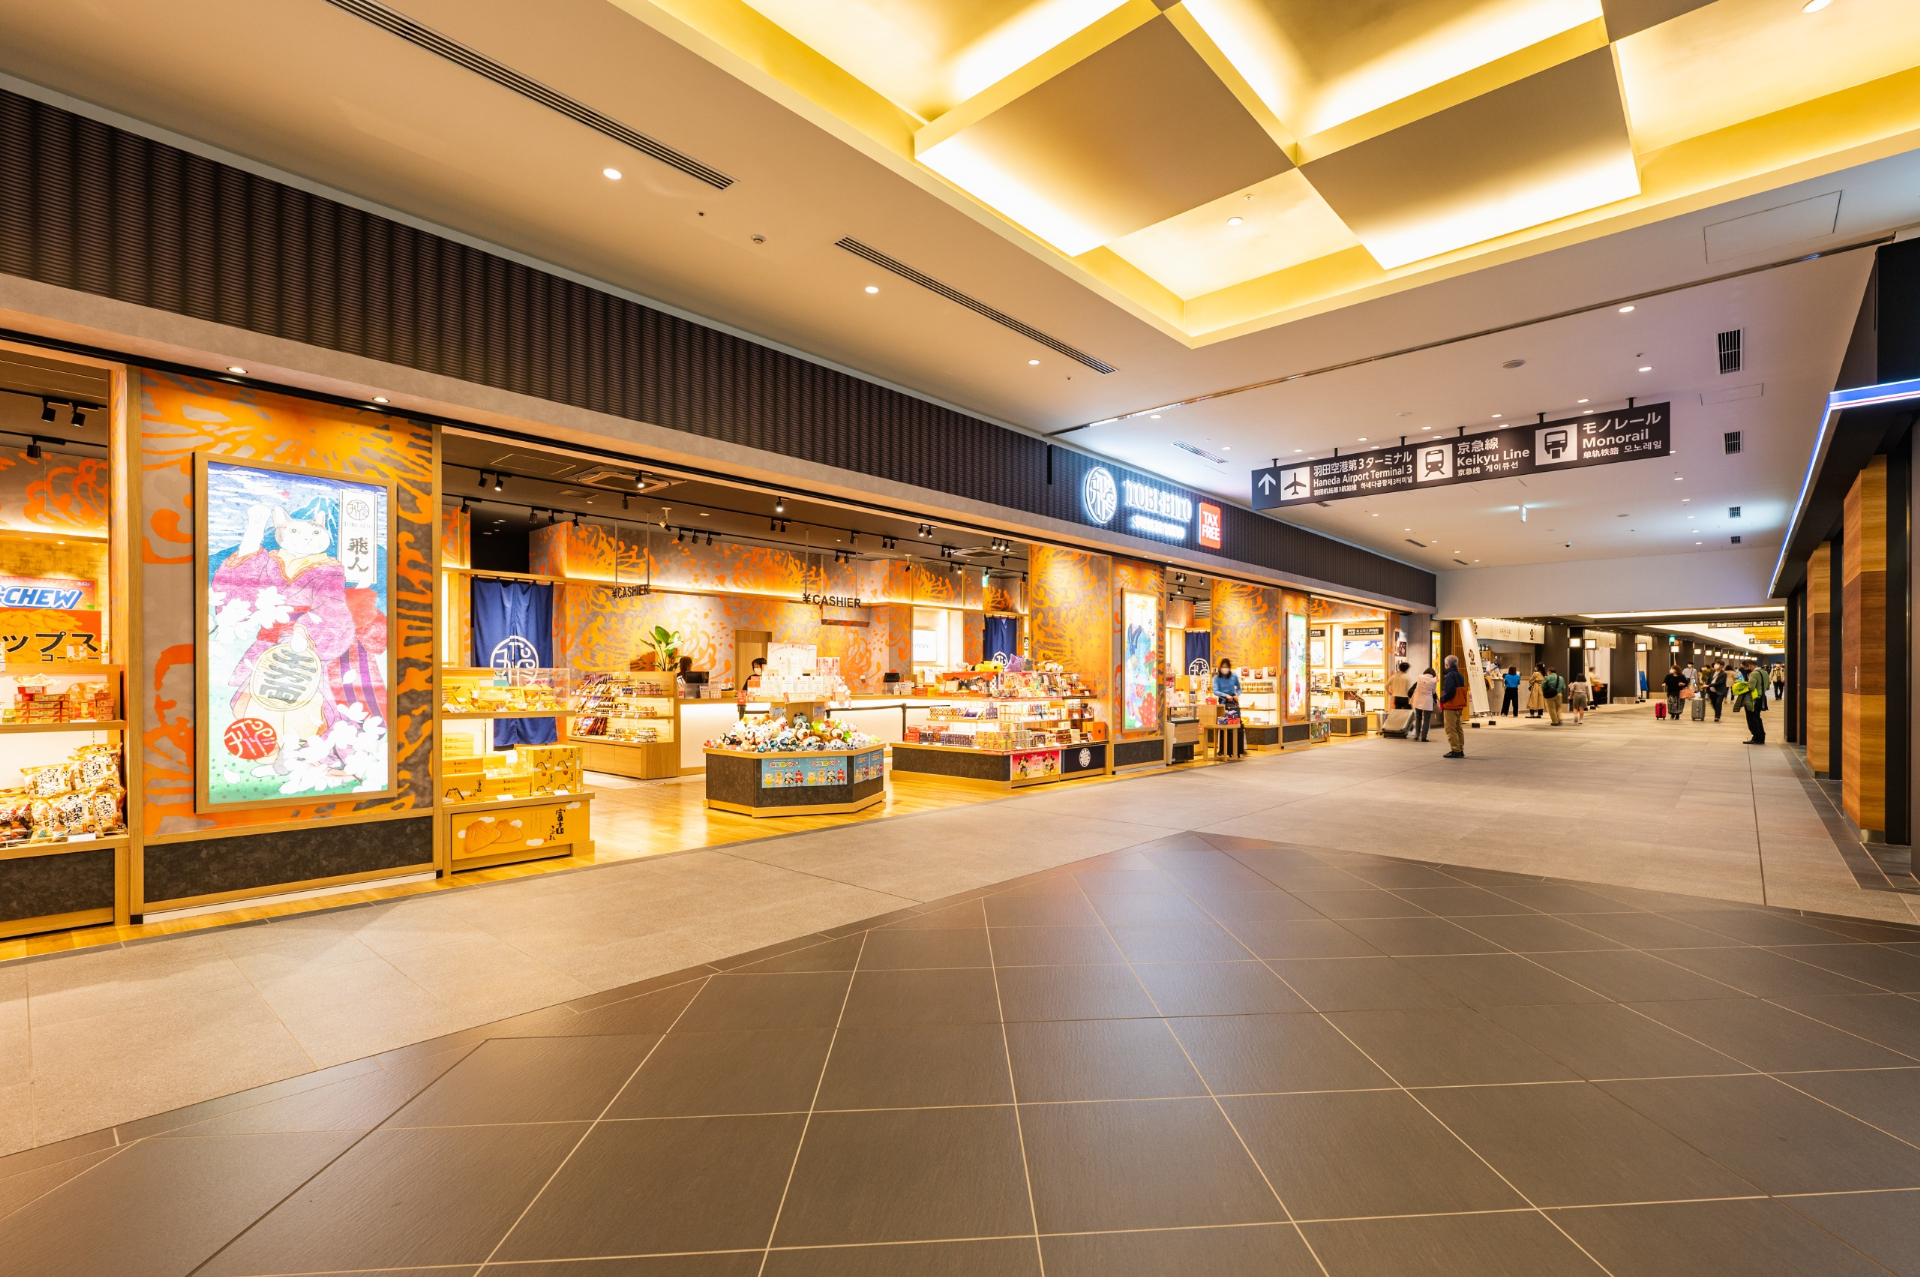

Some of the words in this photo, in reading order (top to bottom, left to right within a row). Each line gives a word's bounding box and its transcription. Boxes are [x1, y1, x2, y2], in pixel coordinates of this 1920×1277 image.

[1582, 412, 1661, 435] モノレール
[1457, 437, 1499, 454] 京急線
[1582, 429, 1649, 449] Monorail
[1624, 440, 1662, 453] 모노레일
[1457, 451, 1499, 467] Keikyu
[1503, 448, 1530, 460] Line
[1313, 474, 1341, 488] Haneda
[1342, 470, 1370, 485] Airport
[1370, 465, 1405, 479] Terminal
[1406, 464, 1413, 474] 3
[1202, 510, 1219, 528] TAX
[1202, 524, 1220, 541] FREE
[41, 653, 100, 662] コーー
